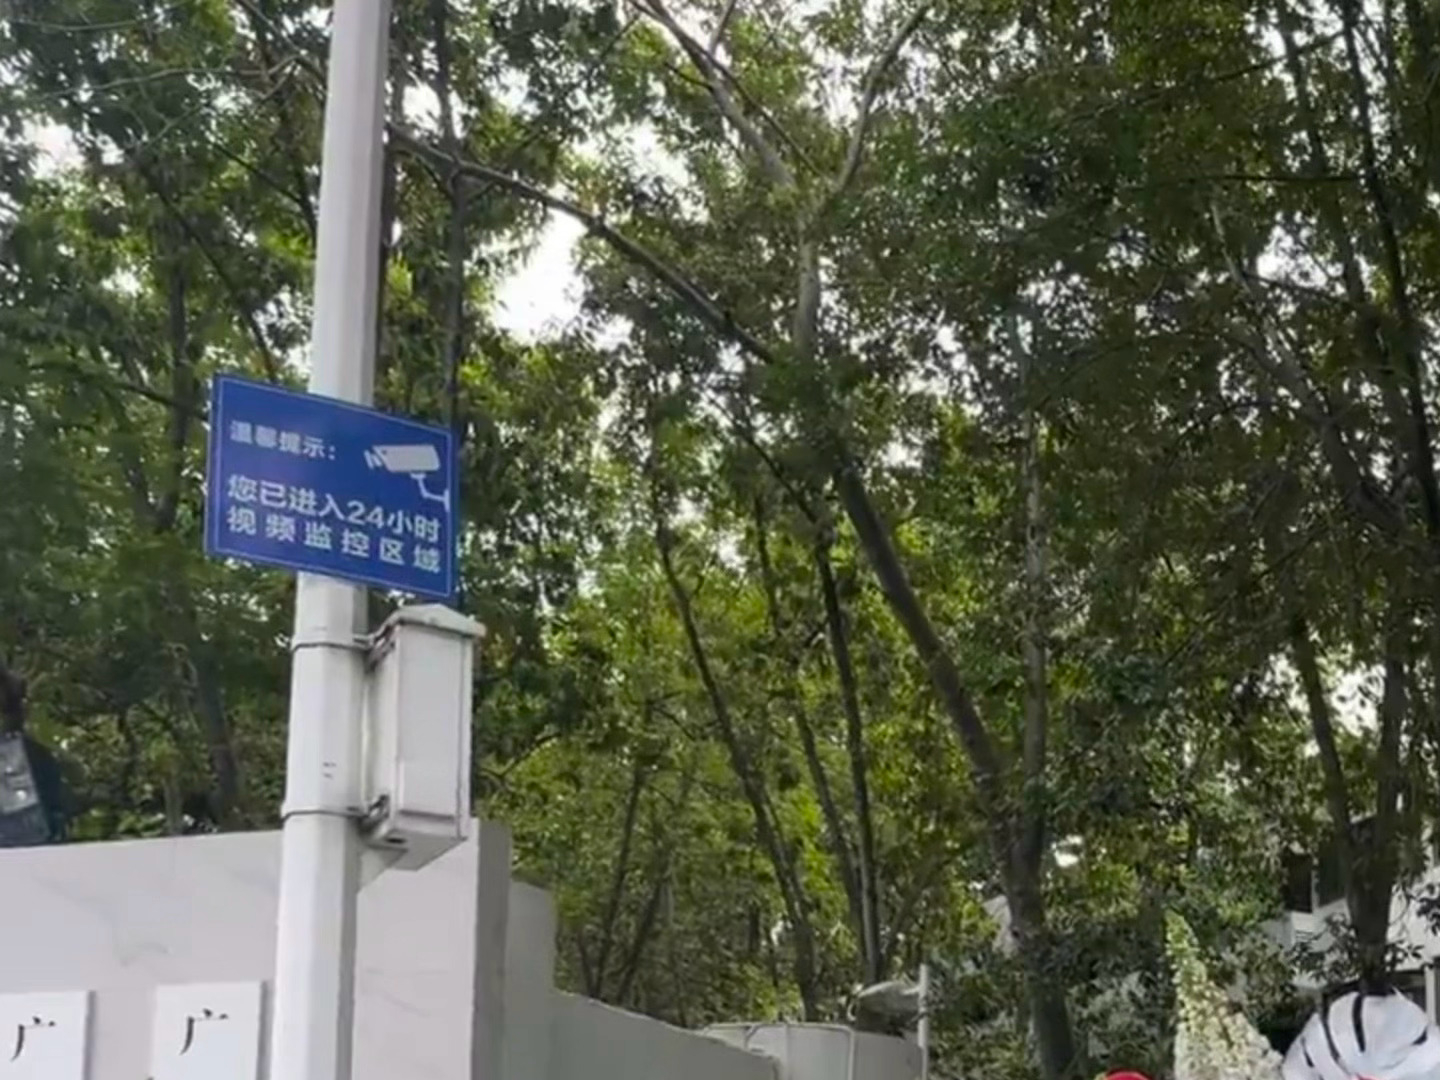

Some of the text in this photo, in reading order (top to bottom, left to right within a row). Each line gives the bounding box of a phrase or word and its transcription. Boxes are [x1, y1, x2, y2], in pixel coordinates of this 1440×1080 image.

[226, 473, 441, 543] 您已进入24小时
[226, 504, 441, 574] 视频监控区域
